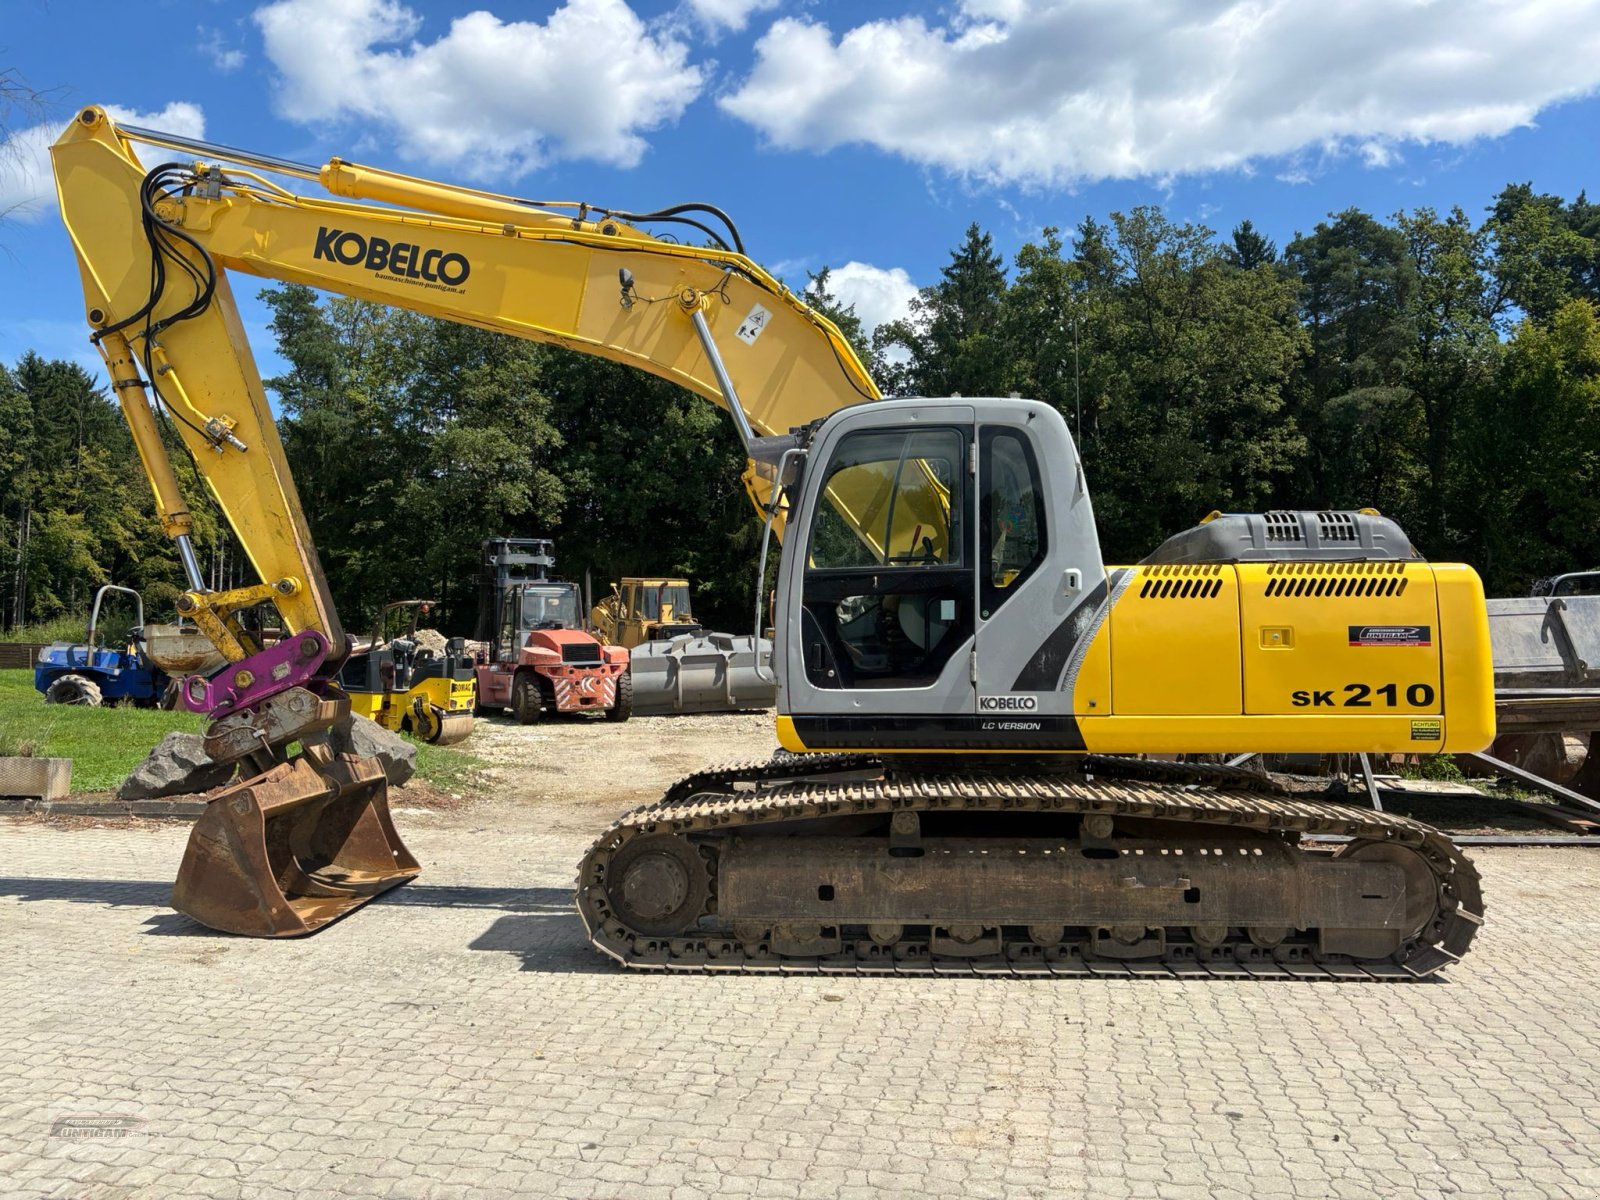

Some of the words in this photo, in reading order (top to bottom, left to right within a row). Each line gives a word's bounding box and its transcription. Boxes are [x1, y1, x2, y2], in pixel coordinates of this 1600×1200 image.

[314, 226, 470, 286] KOBELCO
[375, 272, 466, 294] baumaschinen-puntigam.at
[980, 697, 1036, 710] KOBELCO
[1292, 691, 1336, 707] SK
[1343, 683, 1435, 707] 210
[982, 722, 996, 730] LC
[998, 722, 1041, 730] VERSION
